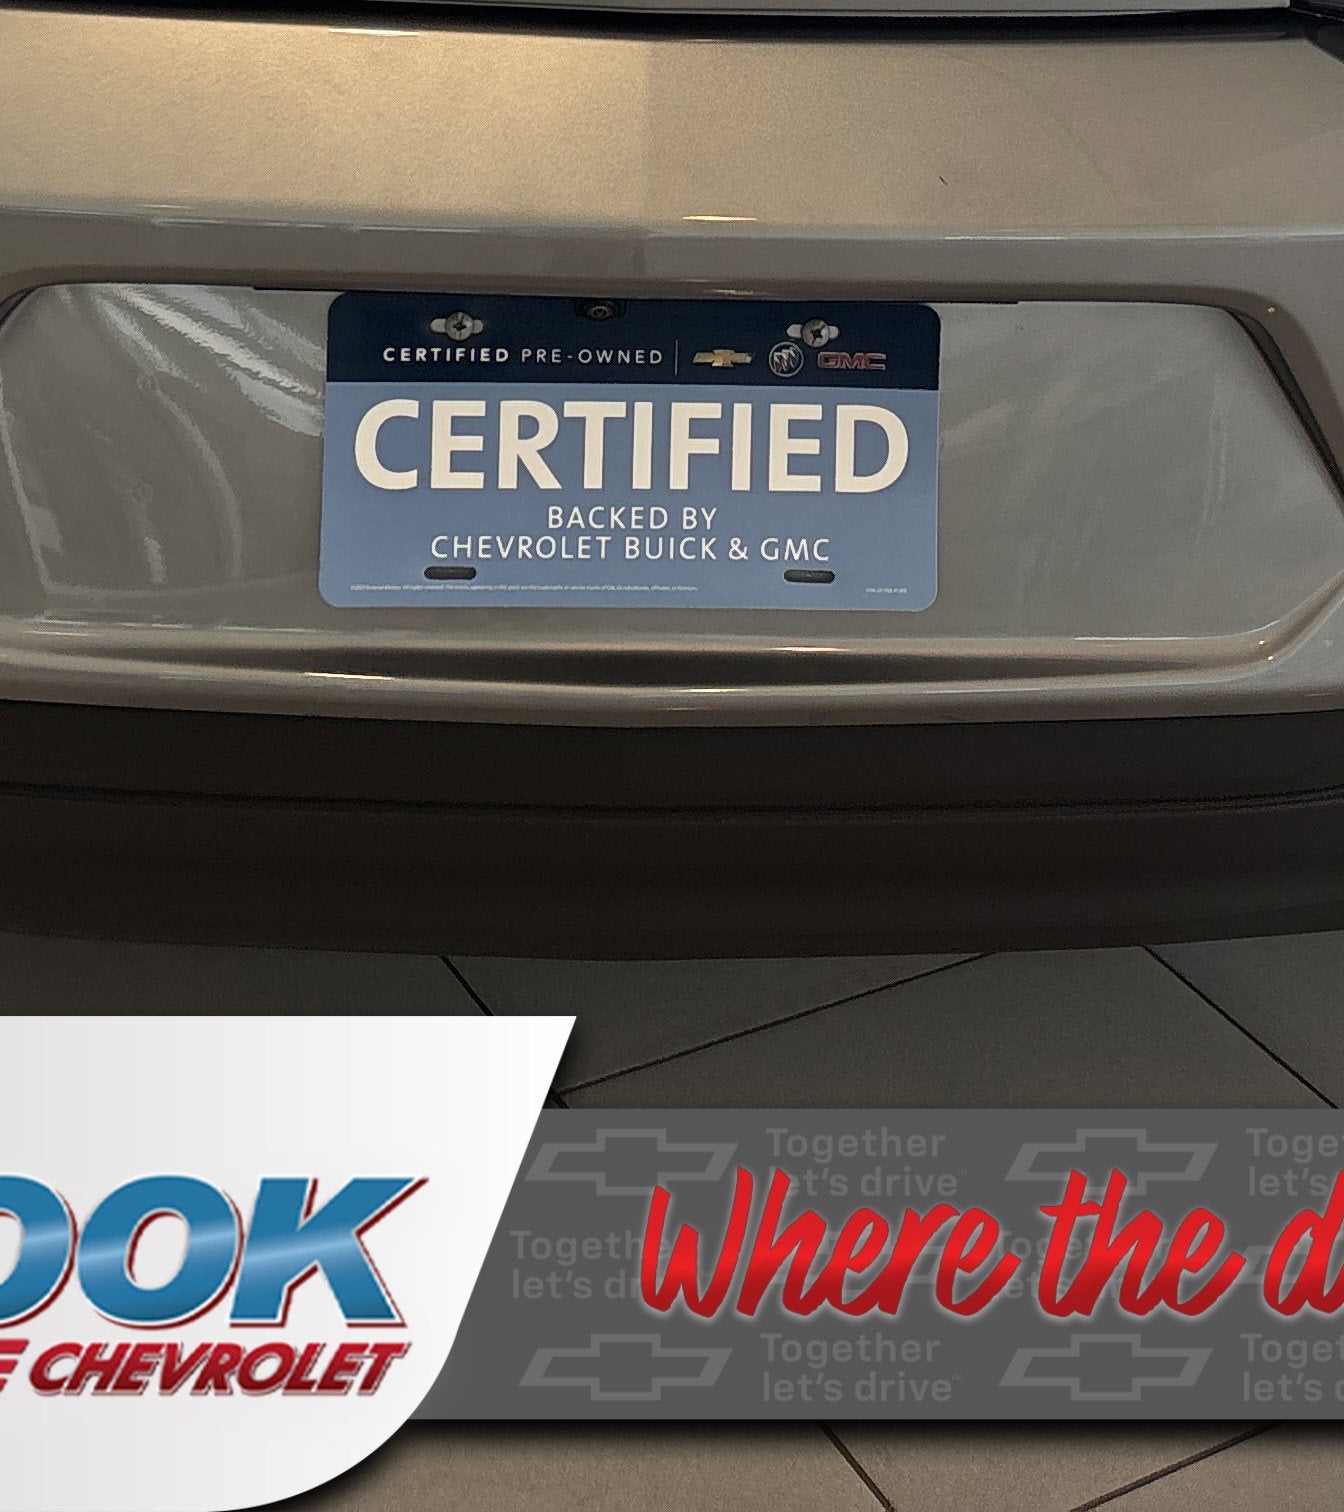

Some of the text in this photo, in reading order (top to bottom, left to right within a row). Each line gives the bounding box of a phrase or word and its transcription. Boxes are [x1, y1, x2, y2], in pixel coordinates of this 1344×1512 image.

[382, 347, 887, 371] CERTIFIED PRE-OWNED GMC
[353, 398, 910, 494] CERTIFIED
[547, 506, 718, 531] BACKED BY
[430, 535, 831, 563] CHEVROLET BUICK & GMC
